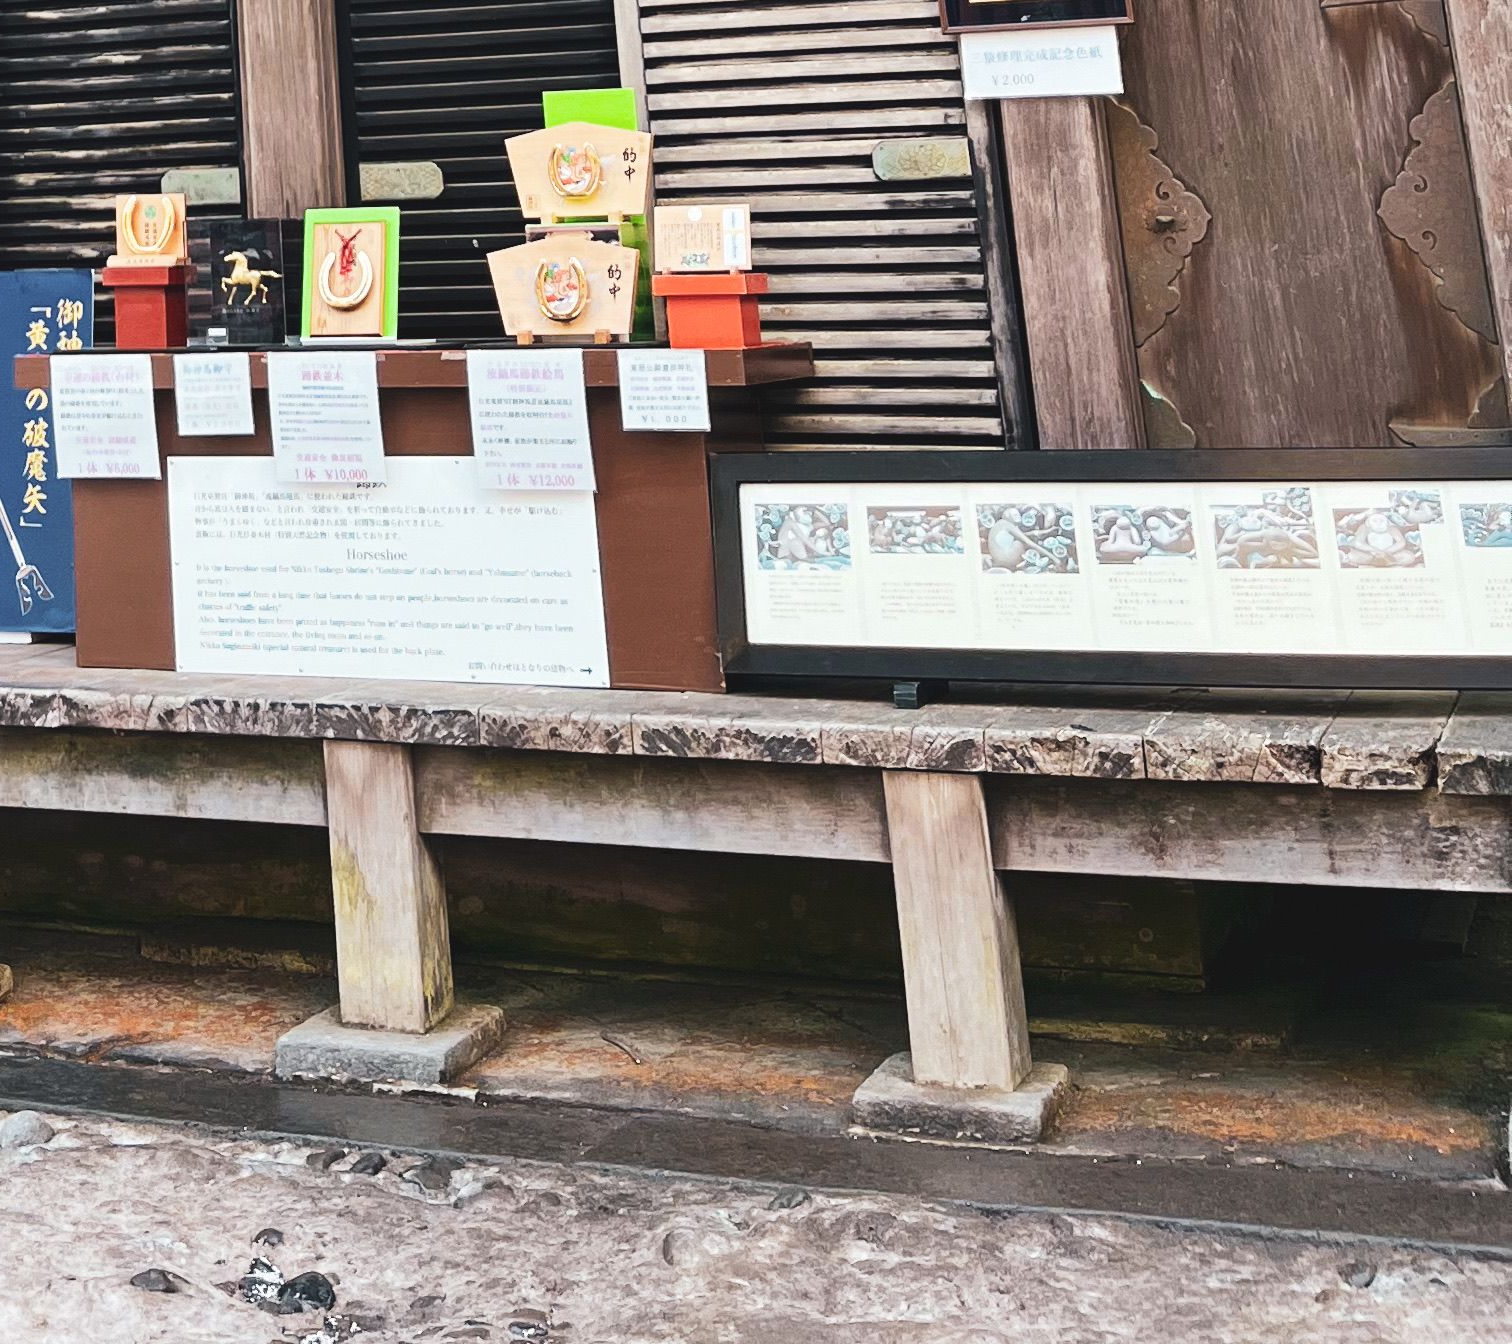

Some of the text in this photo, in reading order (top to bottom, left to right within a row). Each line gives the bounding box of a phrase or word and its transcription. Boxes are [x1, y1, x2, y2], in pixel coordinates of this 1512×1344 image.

[622, 147, 637, 182] 的中
[607, 264, 622, 303] 的中
[345, 548, 408, 561] Horseshoe
